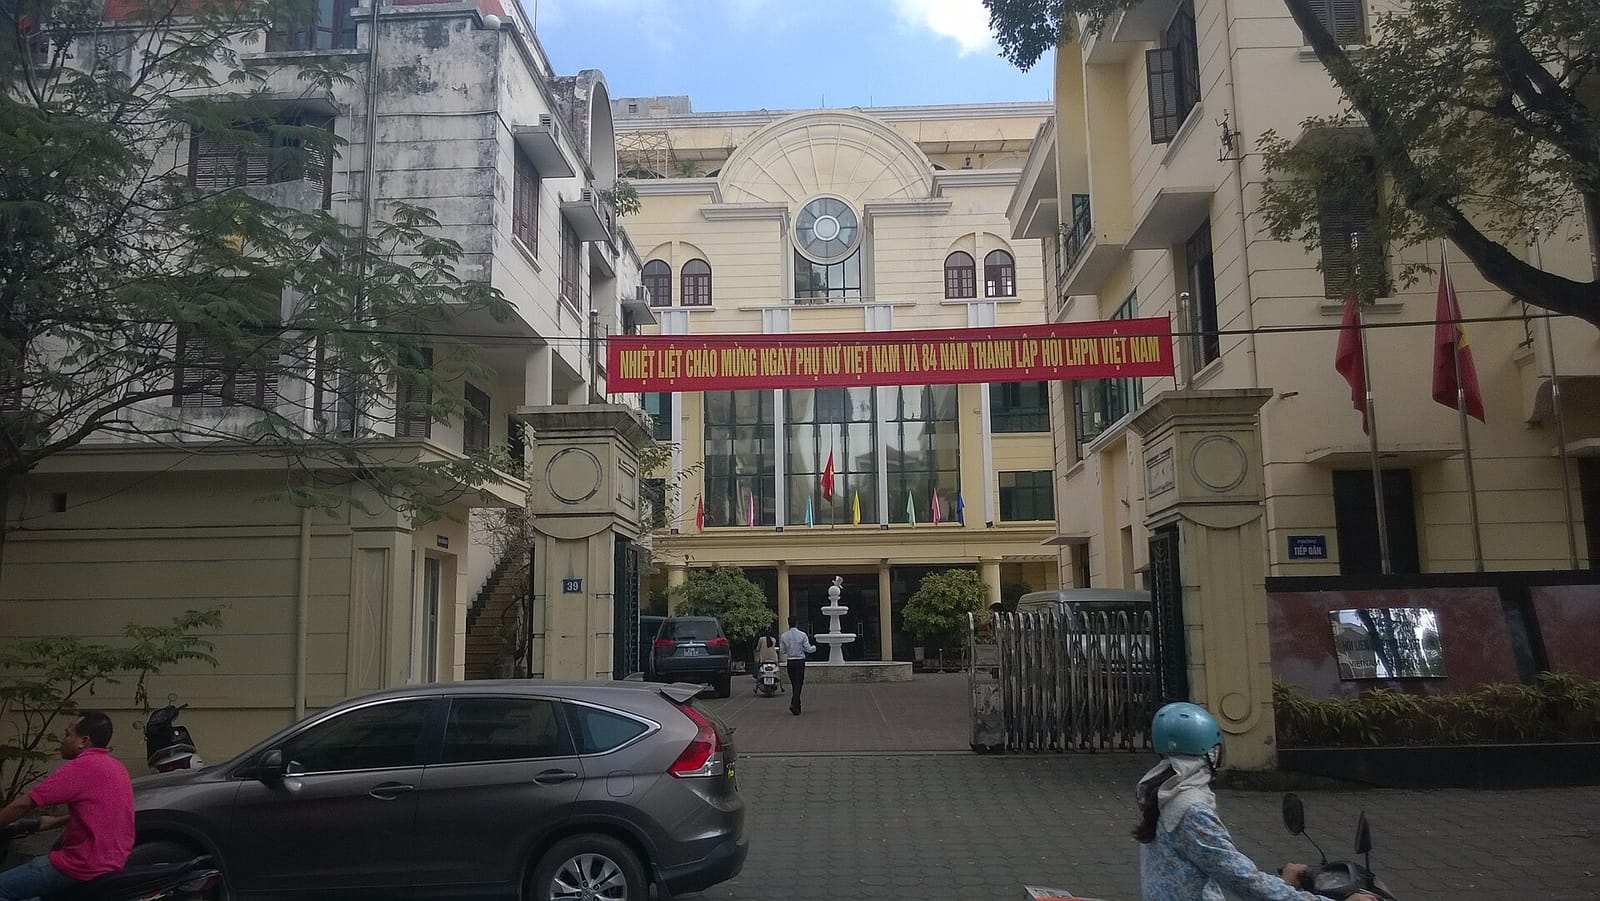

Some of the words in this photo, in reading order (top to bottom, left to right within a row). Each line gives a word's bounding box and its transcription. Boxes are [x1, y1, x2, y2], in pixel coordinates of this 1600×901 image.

[620, 343, 655, 385] NHIỆT
[657, 343, 683, 385] LIỆT
[685, 343, 718, 378] CHÀO
[721, 341, 757, 377] MỪNG
[760, 341, 792, 376] NGÀY
[795, 346, 820, 381] PHỤ
[823, 341, 842, 375] NỮ
[843, 341, 868, 380] VIỆT
[871, 344, 900, 373] NAM
[902, 338, 920, 371] VÀ
[922, 343, 938, 371] 84
[940, 336, 969, 370] NĂM
[971, 334, 1013, 370] THÀNH
[1015, 333, 1038, 374] LẬP
[1041, 332, 1063, 373] HỘI
[1065, 337, 1099, 366] LHPN
[1101, 328, 1127, 370] VIỆT
[1130, 336, 1160, 363] NAM
[1294, 544, 1307, 556] TIẾP
[567, 581, 579, 591] 39
